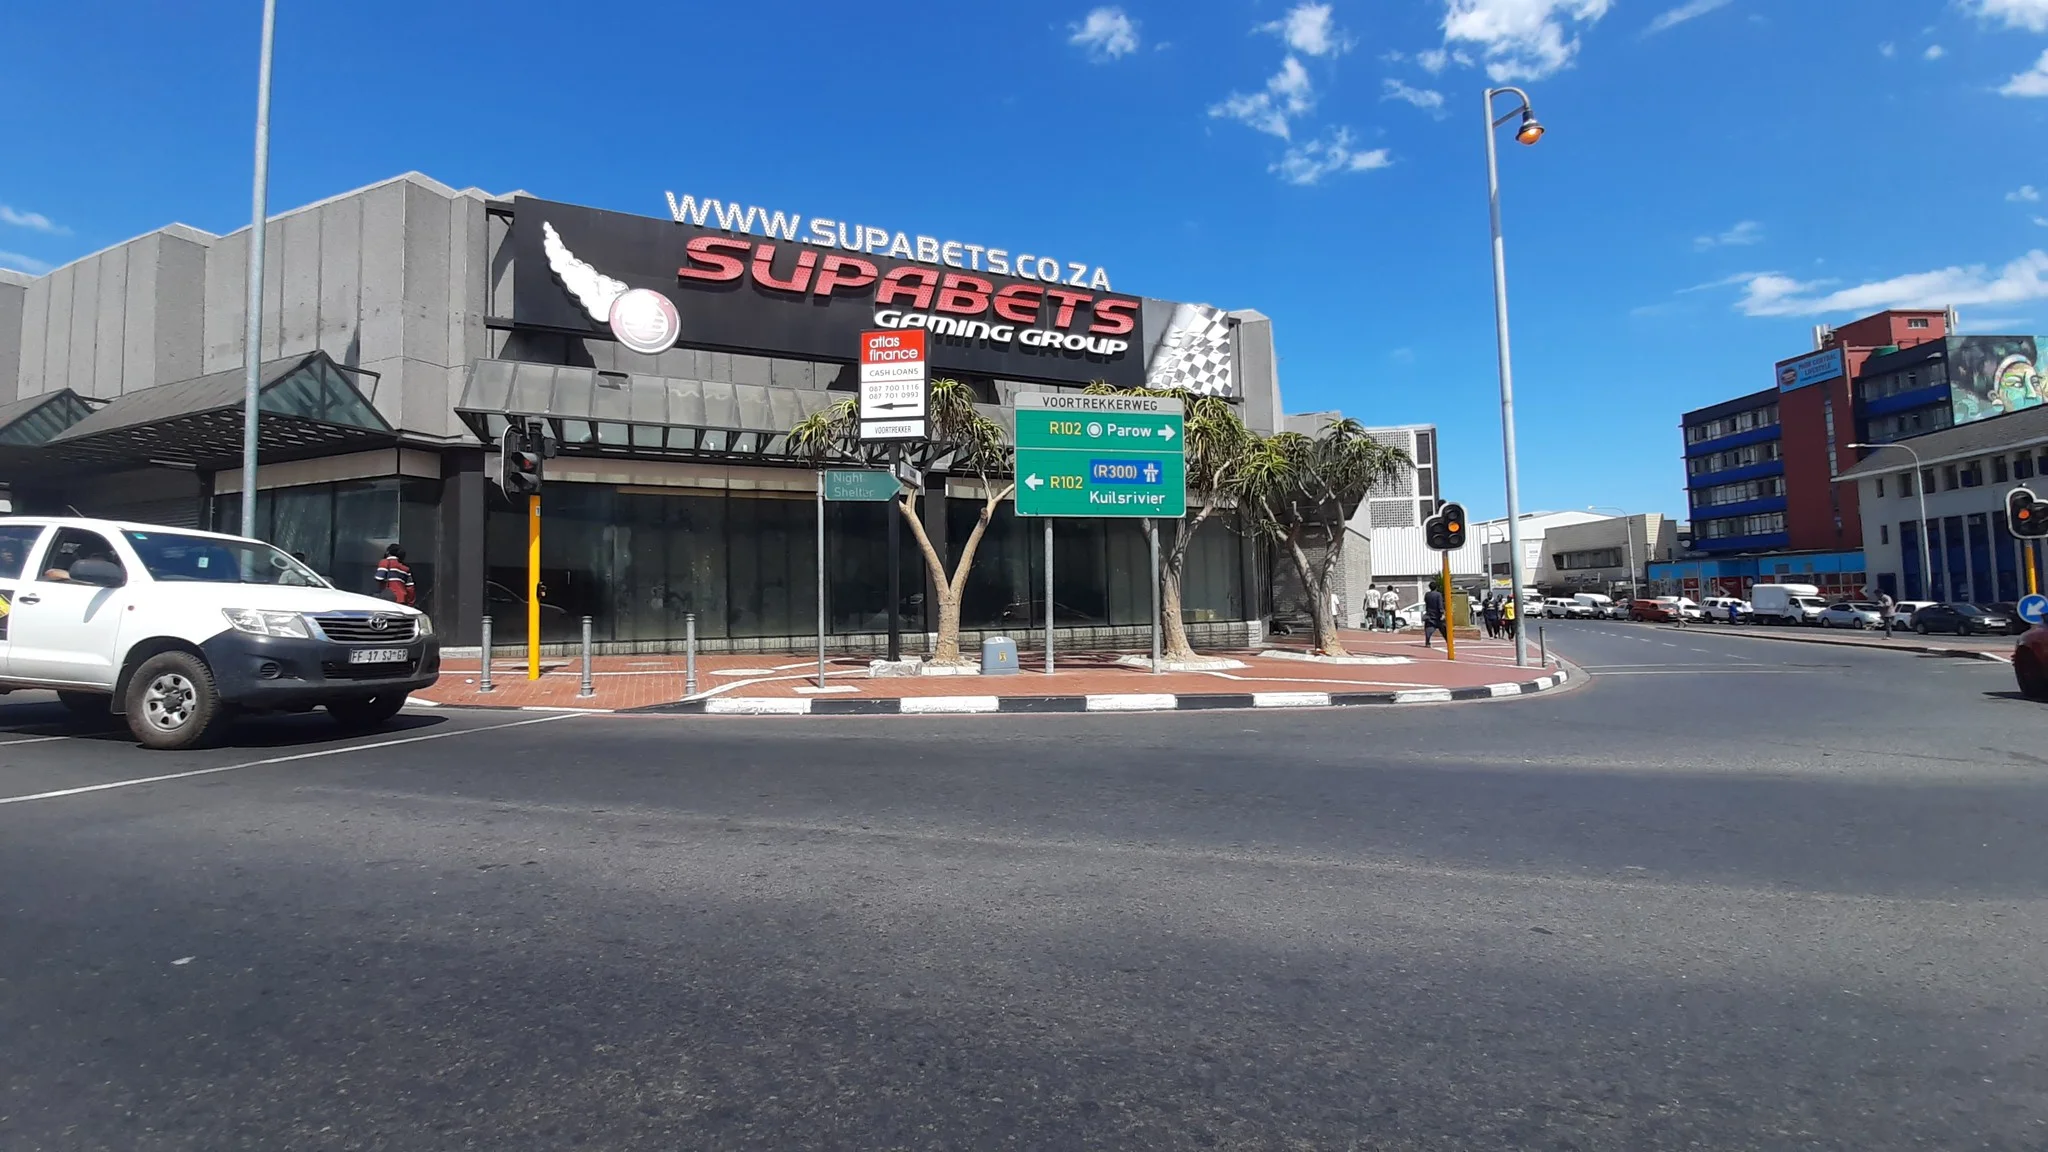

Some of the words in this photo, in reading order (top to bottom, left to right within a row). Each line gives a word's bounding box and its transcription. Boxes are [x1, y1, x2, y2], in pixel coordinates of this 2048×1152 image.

[665, 191, 1111, 292] WWW.SUPABETS.CO.ZA
[677, 236, 1140, 336] SUPABETS
[874, 310, 1015, 343] GAMING
[1018, 329, 1128, 356] GROUP
[869, 336, 900, 348] atlas
[869, 349, 918, 361] finance
[869, 369, 891, 377] CASH
[892, 368, 919, 376] LOANS
[1042, 396, 1158, 411] VOORTREKKERWEG
[874, 425, 912, 434] VOORTREKKER
[1049, 421, 1082, 436] R102
[1107, 423, 1152, 437] Parow
[833, 472, 863, 486] Night
[1093, 464, 1138, 480] (R300)
[1049, 475, 1083, 490] R102
[834, 486, 875, 498] Shelter
[1089, 490, 1166, 505] Kuilsrivier
[351, 651, 363, 662] FF
[368, 650, 379, 662] 17
[382, 650, 393, 661] SJ
[397, 649, 408, 660] GP
